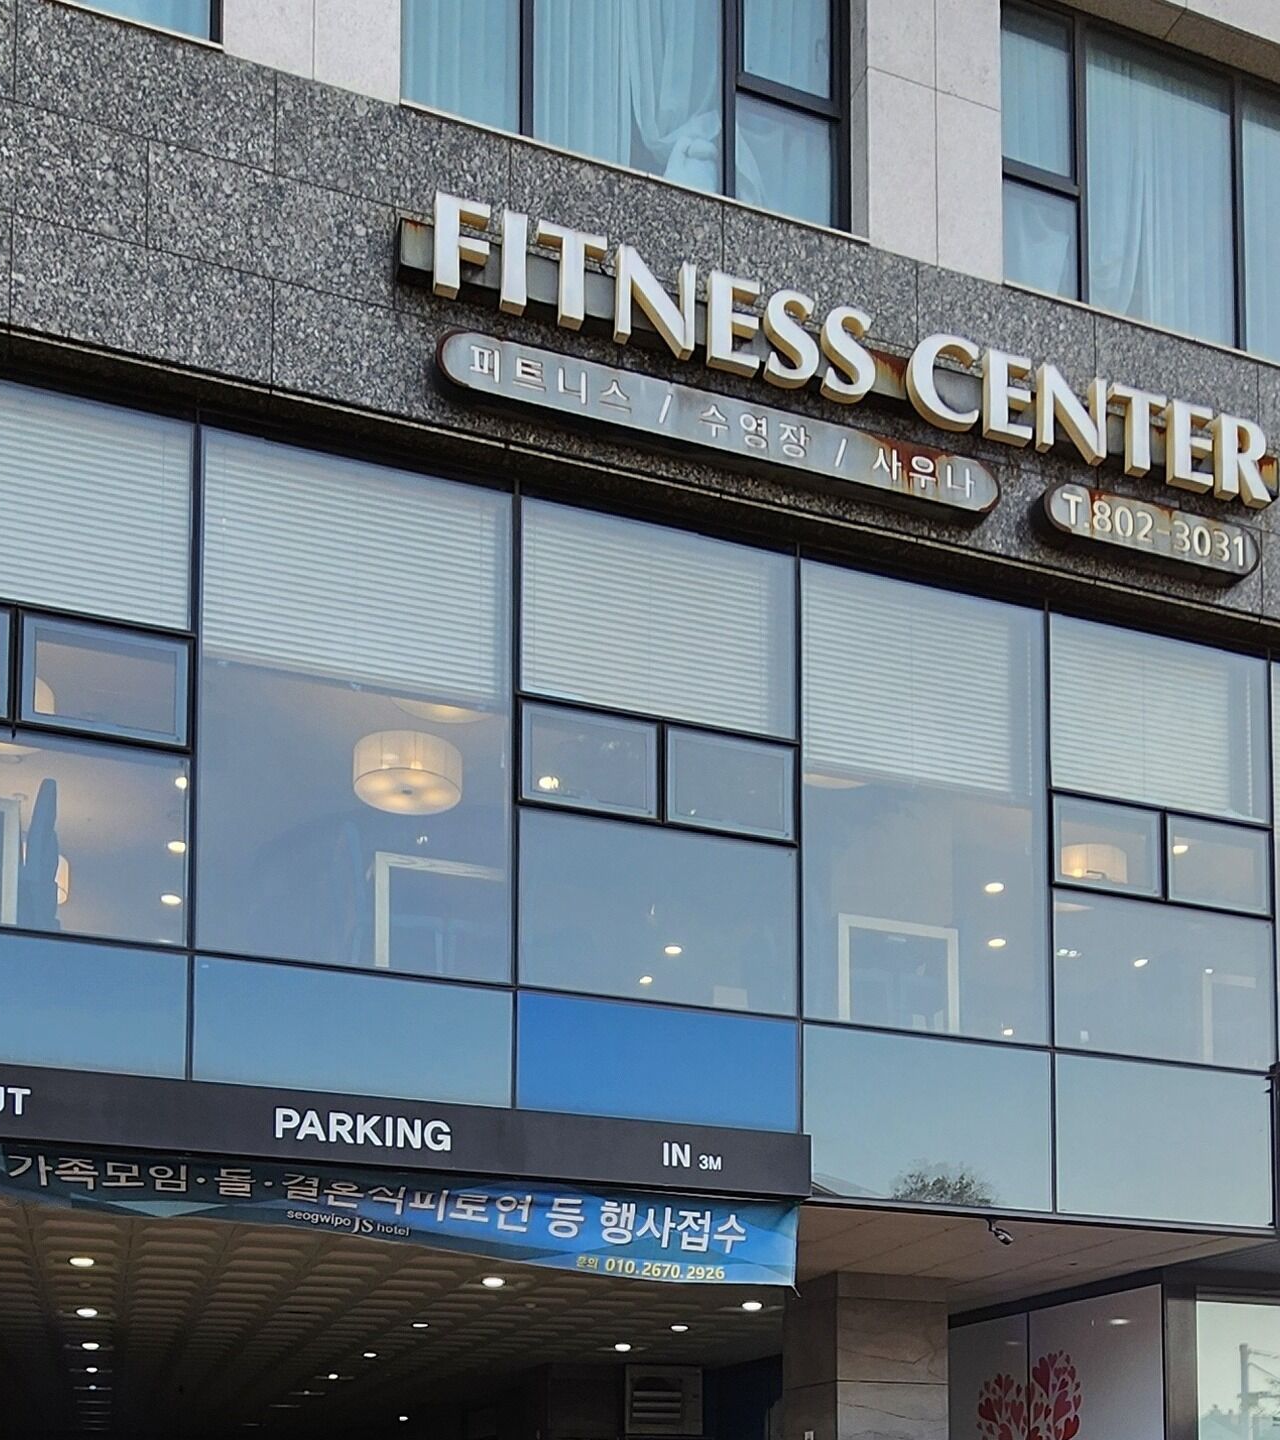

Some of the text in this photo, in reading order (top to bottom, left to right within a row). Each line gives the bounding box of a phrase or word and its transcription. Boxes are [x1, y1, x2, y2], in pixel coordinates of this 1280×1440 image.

[433, 191, 1273, 510] FITNESS CENTER
[469, 344, 632, 413] 피트니스
[697, 402, 811, 459] 수영장
[871, 447, 975, 500] 사우나
[1061, 492, 1245, 568] T.802-3031
[274, 1106, 453, 1152] PARKING
[661, 1141, 692, 1168] IN
[698, 1154, 723, 1171] 3M
[286, 1209, 410, 1237] seogwipo JS hotel
[545, 1197, 585, 1239] 등
[599, 1200, 747, 1254] 행사접수
[604, 1257, 725, 1281] 010.2670.2926
